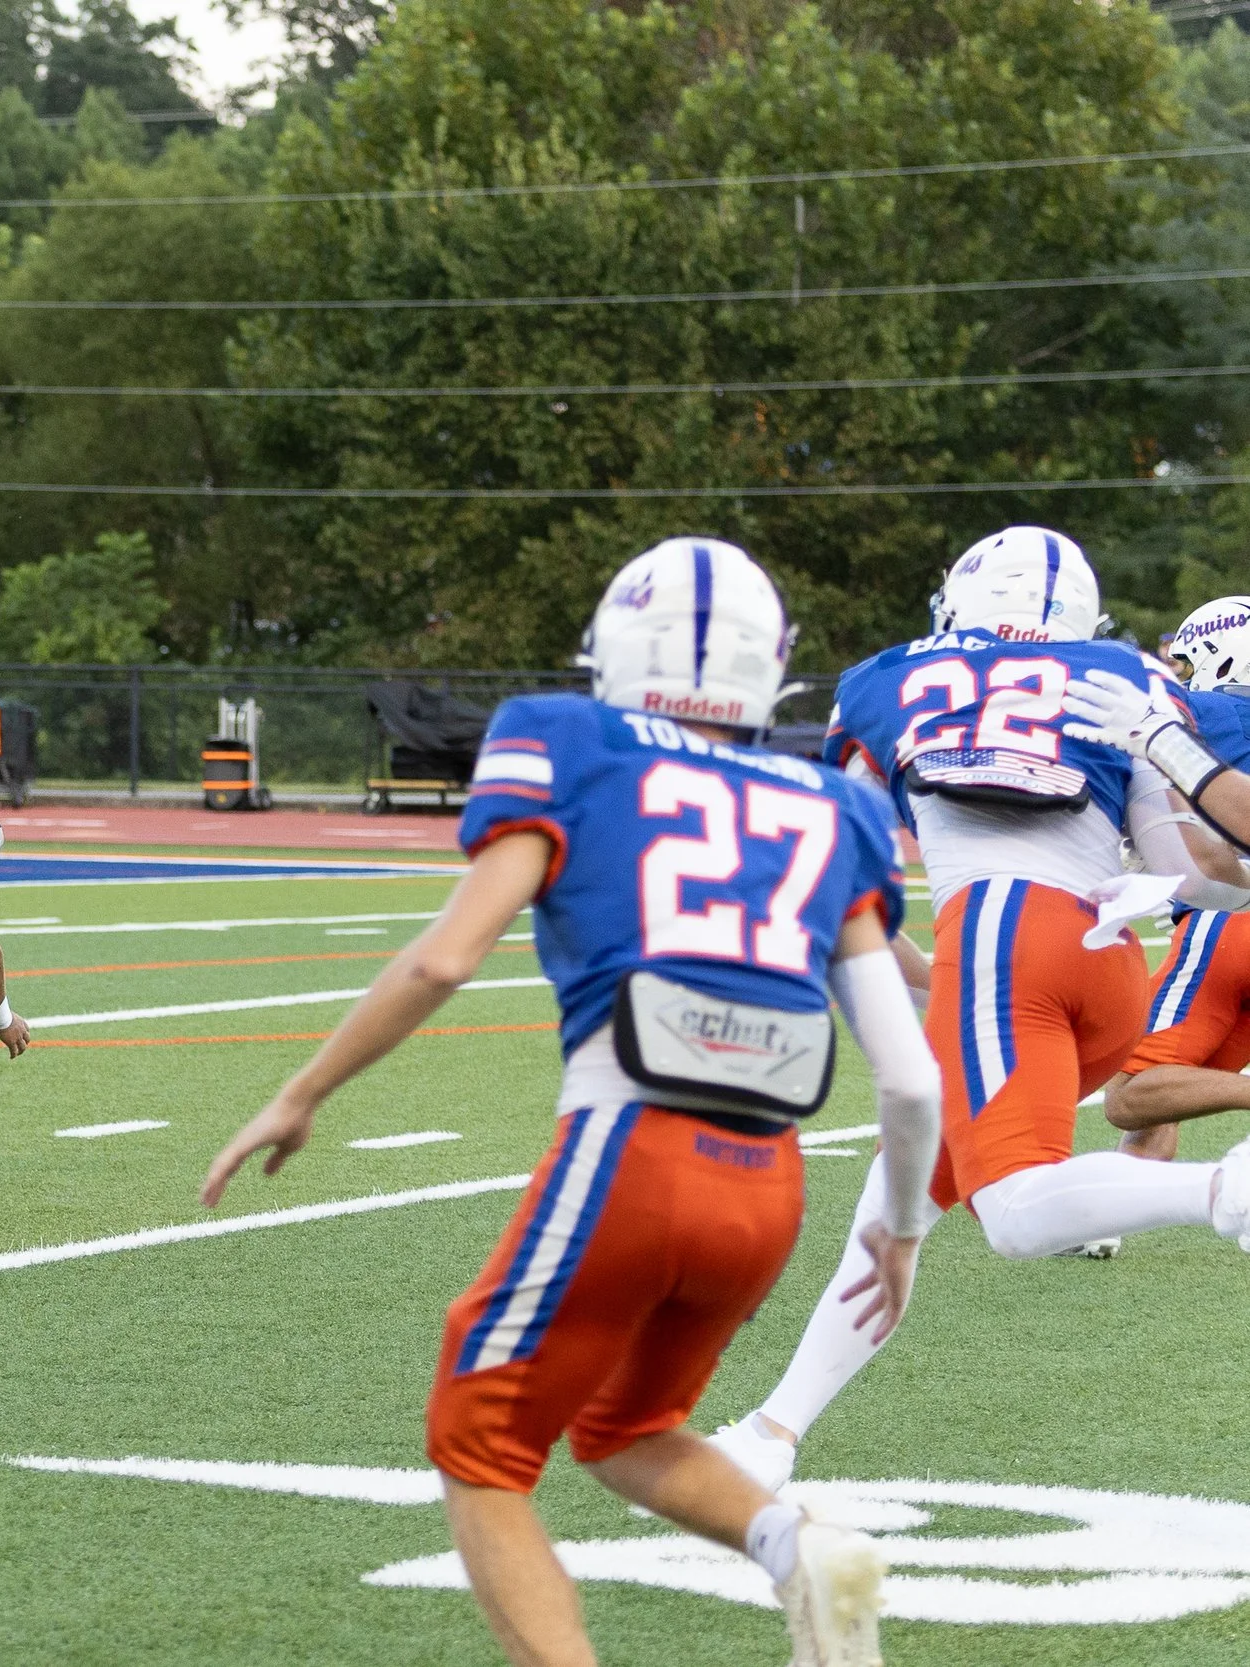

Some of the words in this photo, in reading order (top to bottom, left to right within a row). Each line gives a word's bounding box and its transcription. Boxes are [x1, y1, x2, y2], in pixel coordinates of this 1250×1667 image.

[1180, 613, 1248, 646] Bruins
[643, 692, 744, 721] Riddell
[895, 656, 1070, 770] 22
[638, 759, 838, 976] 27
